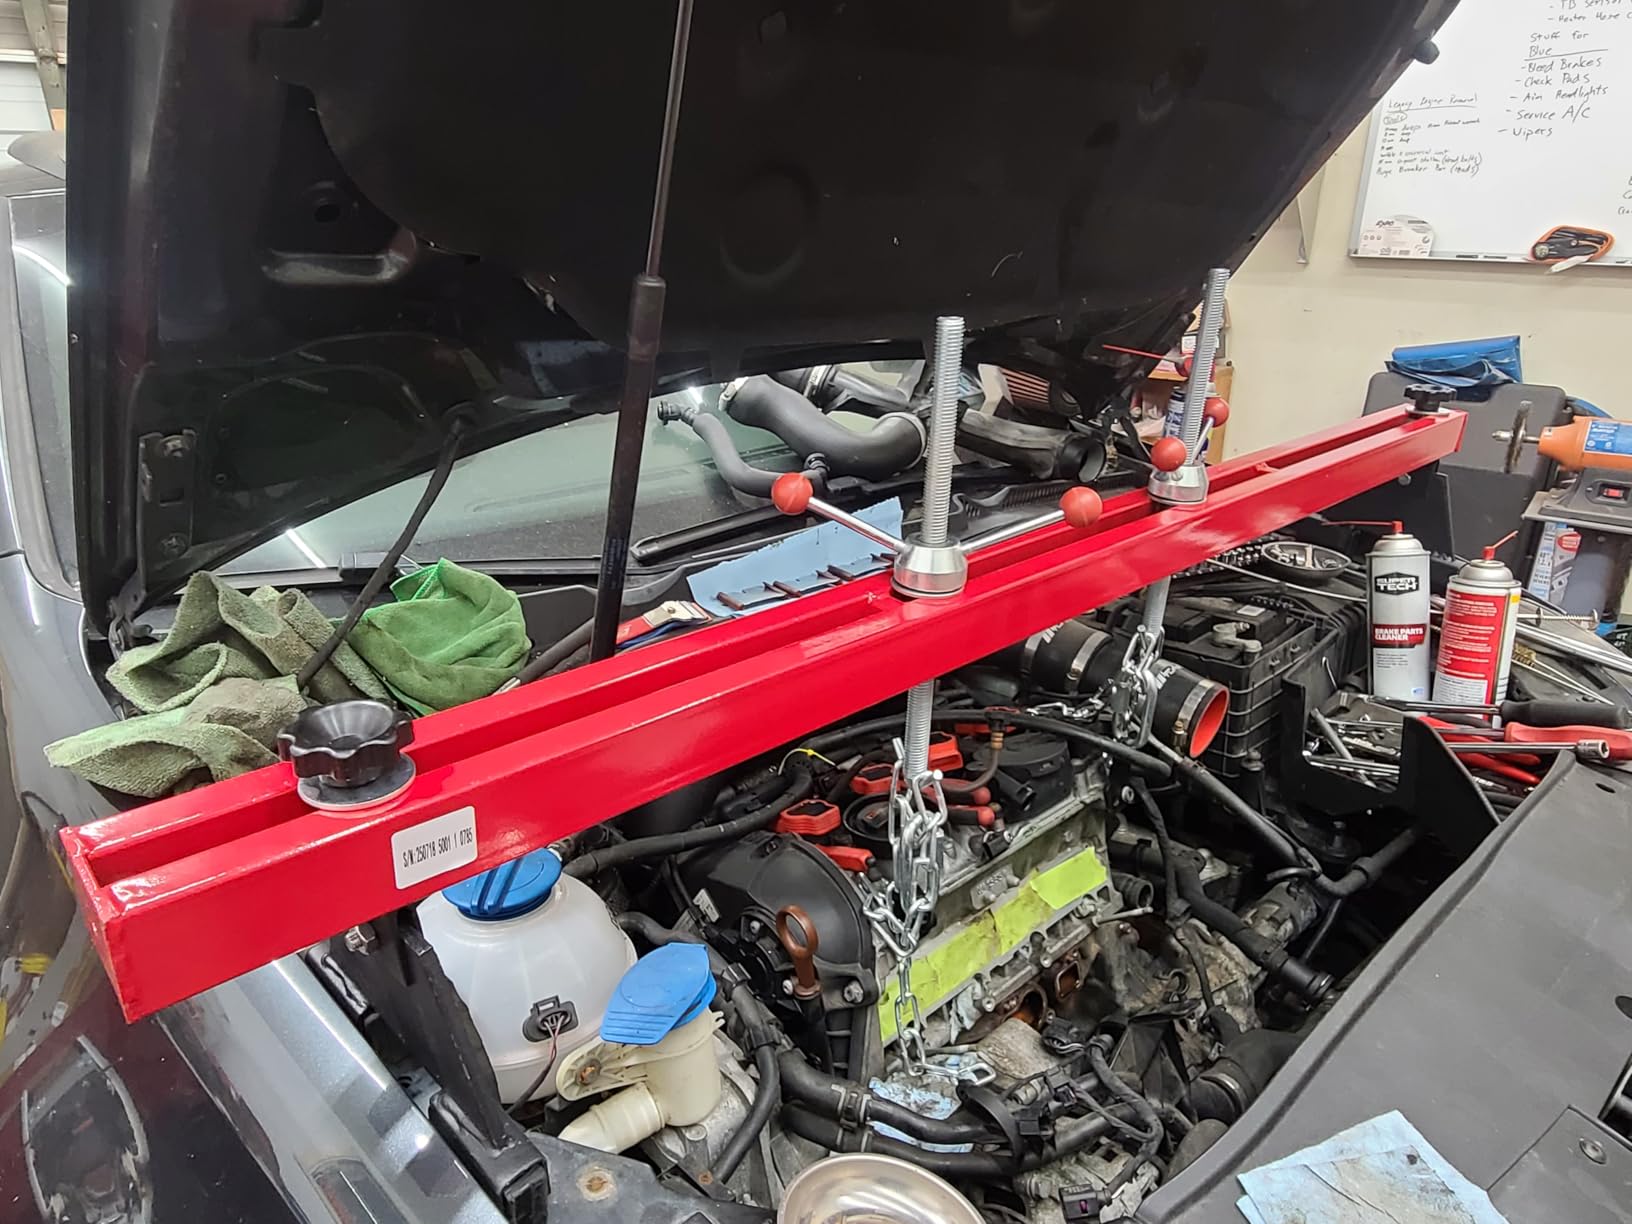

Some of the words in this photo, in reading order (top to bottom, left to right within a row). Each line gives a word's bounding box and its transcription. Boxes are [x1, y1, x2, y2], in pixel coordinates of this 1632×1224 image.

[1530, 31, 1560, 42] Stuff
[1529, 45, 1552, 57] Blue
[1560, 56, 1602, 70] Brakes
[1524, 75, 1552, 87] Check
[1562, 72, 1590, 84] Pads
[1523, 92, 1543, 102] Aim
[1555, 84, 1609, 101] Headlights
[1517, 110, 1556, 120] Service
[1562, 101, 1591, 123] A/C
[1376, 583, 1418, 591] TECH
[1400, 627, 1424, 635] PARTS
